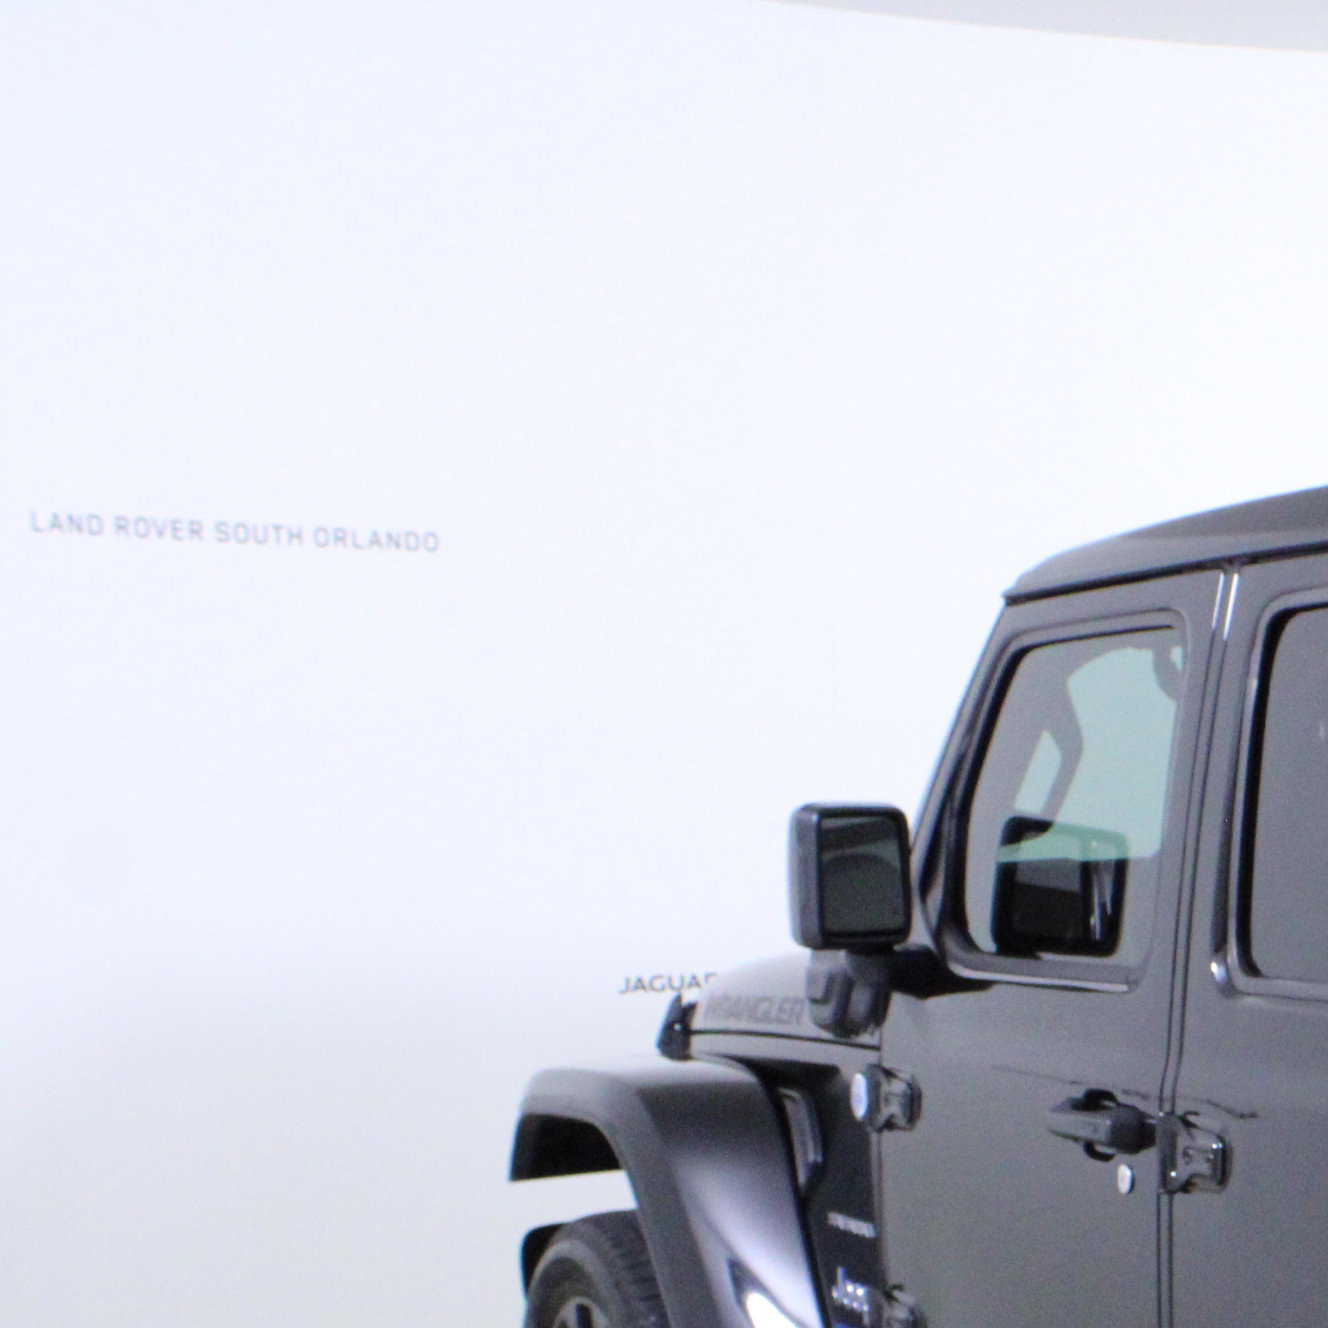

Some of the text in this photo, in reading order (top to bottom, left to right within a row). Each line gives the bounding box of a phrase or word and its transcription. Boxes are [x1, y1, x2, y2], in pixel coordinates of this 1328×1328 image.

[30, 511, 440, 553] LAND ROVER SOUTH ORLANDO
